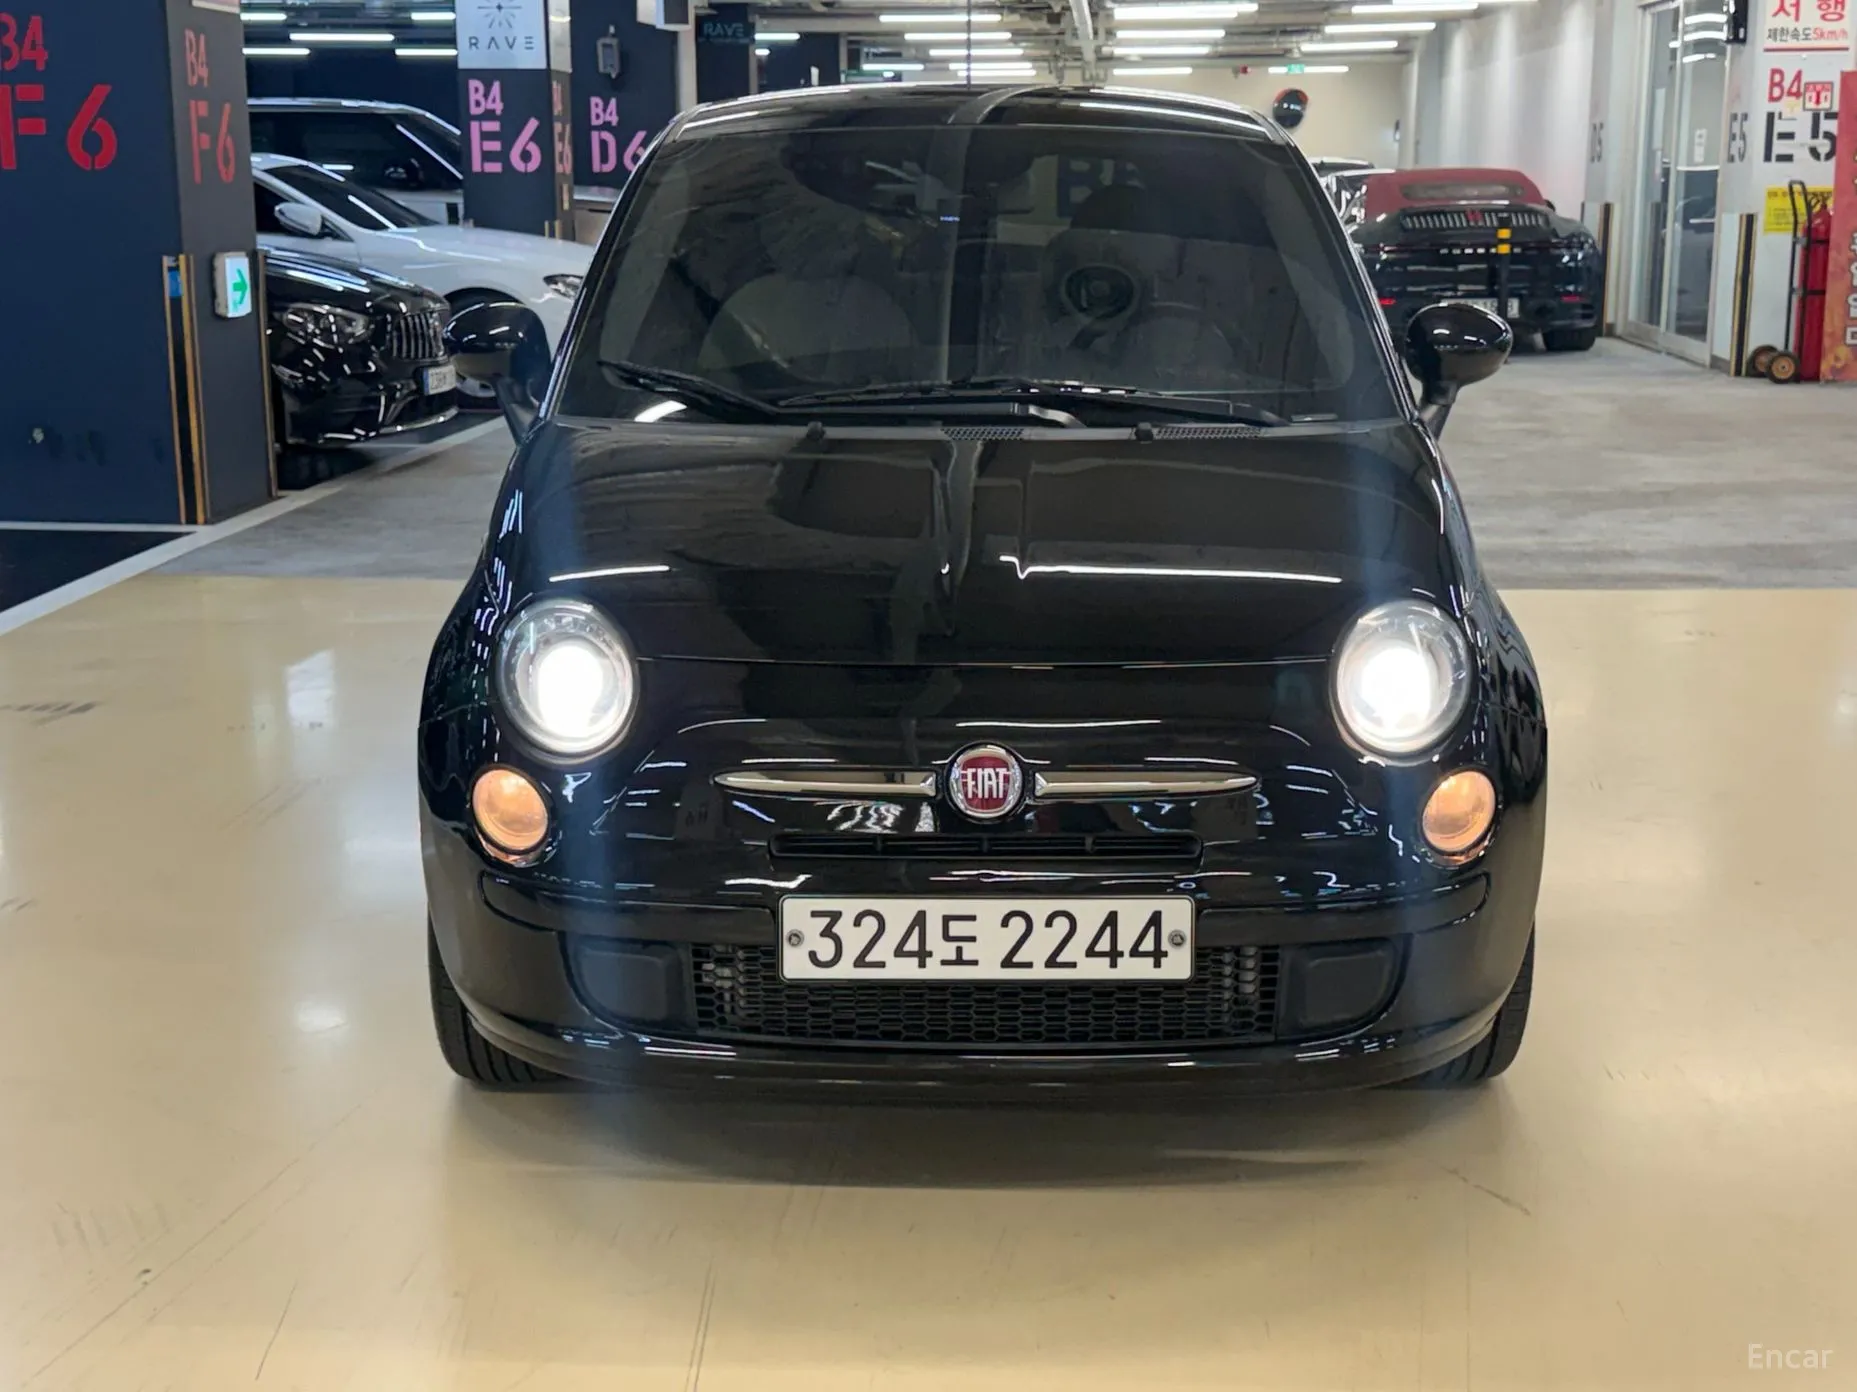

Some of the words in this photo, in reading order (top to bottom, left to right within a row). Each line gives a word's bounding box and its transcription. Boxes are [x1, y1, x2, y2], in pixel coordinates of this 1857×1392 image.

[185, 29, 209, 87] B4
[468, 36, 535, 51] RAVE
[468, 79, 504, 116] B4
[1768, 68, 1803, 103] B4
[590, 96, 619, 126] B4
[470, 117, 542, 174] E6
[591, 130, 647, 174] D6
[966, 766, 1009, 799] FIAT
[808, 909, 979, 969] 324도
[1000, 909, 1168, 969] 2244
